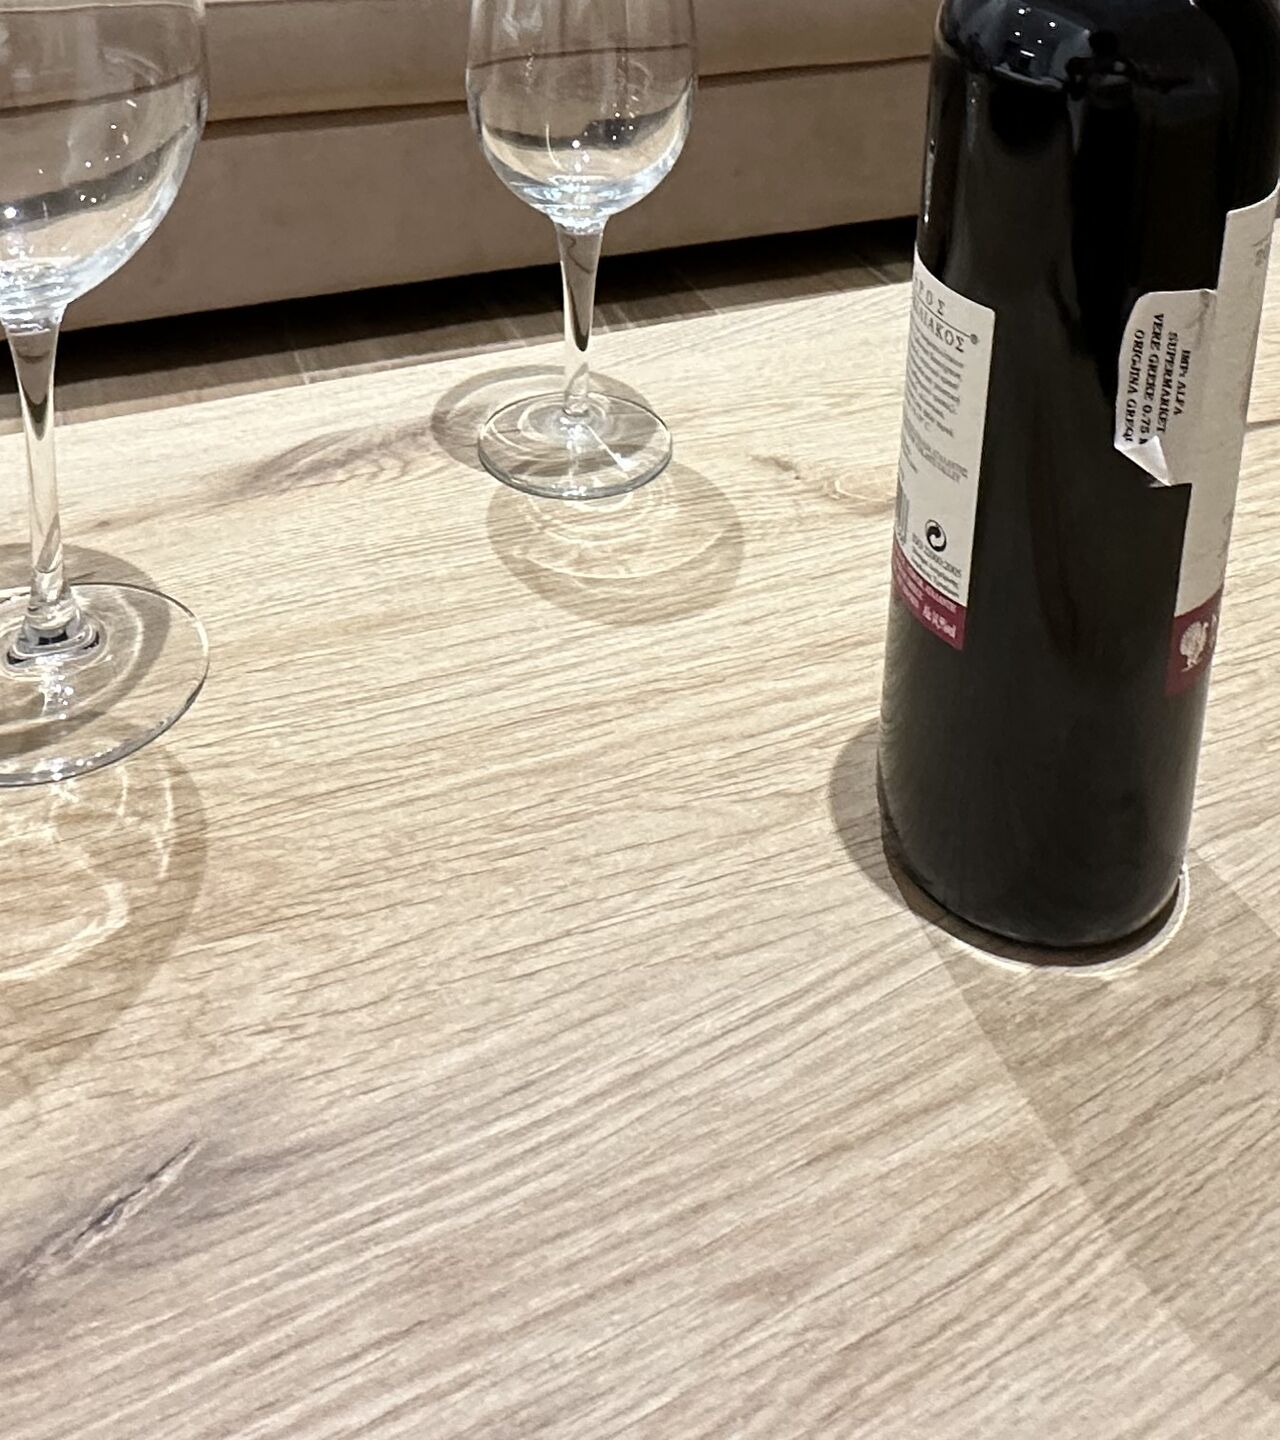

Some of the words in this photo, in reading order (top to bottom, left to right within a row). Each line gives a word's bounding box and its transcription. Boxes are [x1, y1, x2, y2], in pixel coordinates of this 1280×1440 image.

[1151, 313, 1164, 351] VERE
[1128, 329, 1145, 394] ORIGJINA
[1144, 353, 1160, 401] GREKE
[1156, 331, 1178, 433] SUPERMARKET
[1140, 404, 1152, 434] 0.75
[1173, 380, 1187, 415] ALFA
